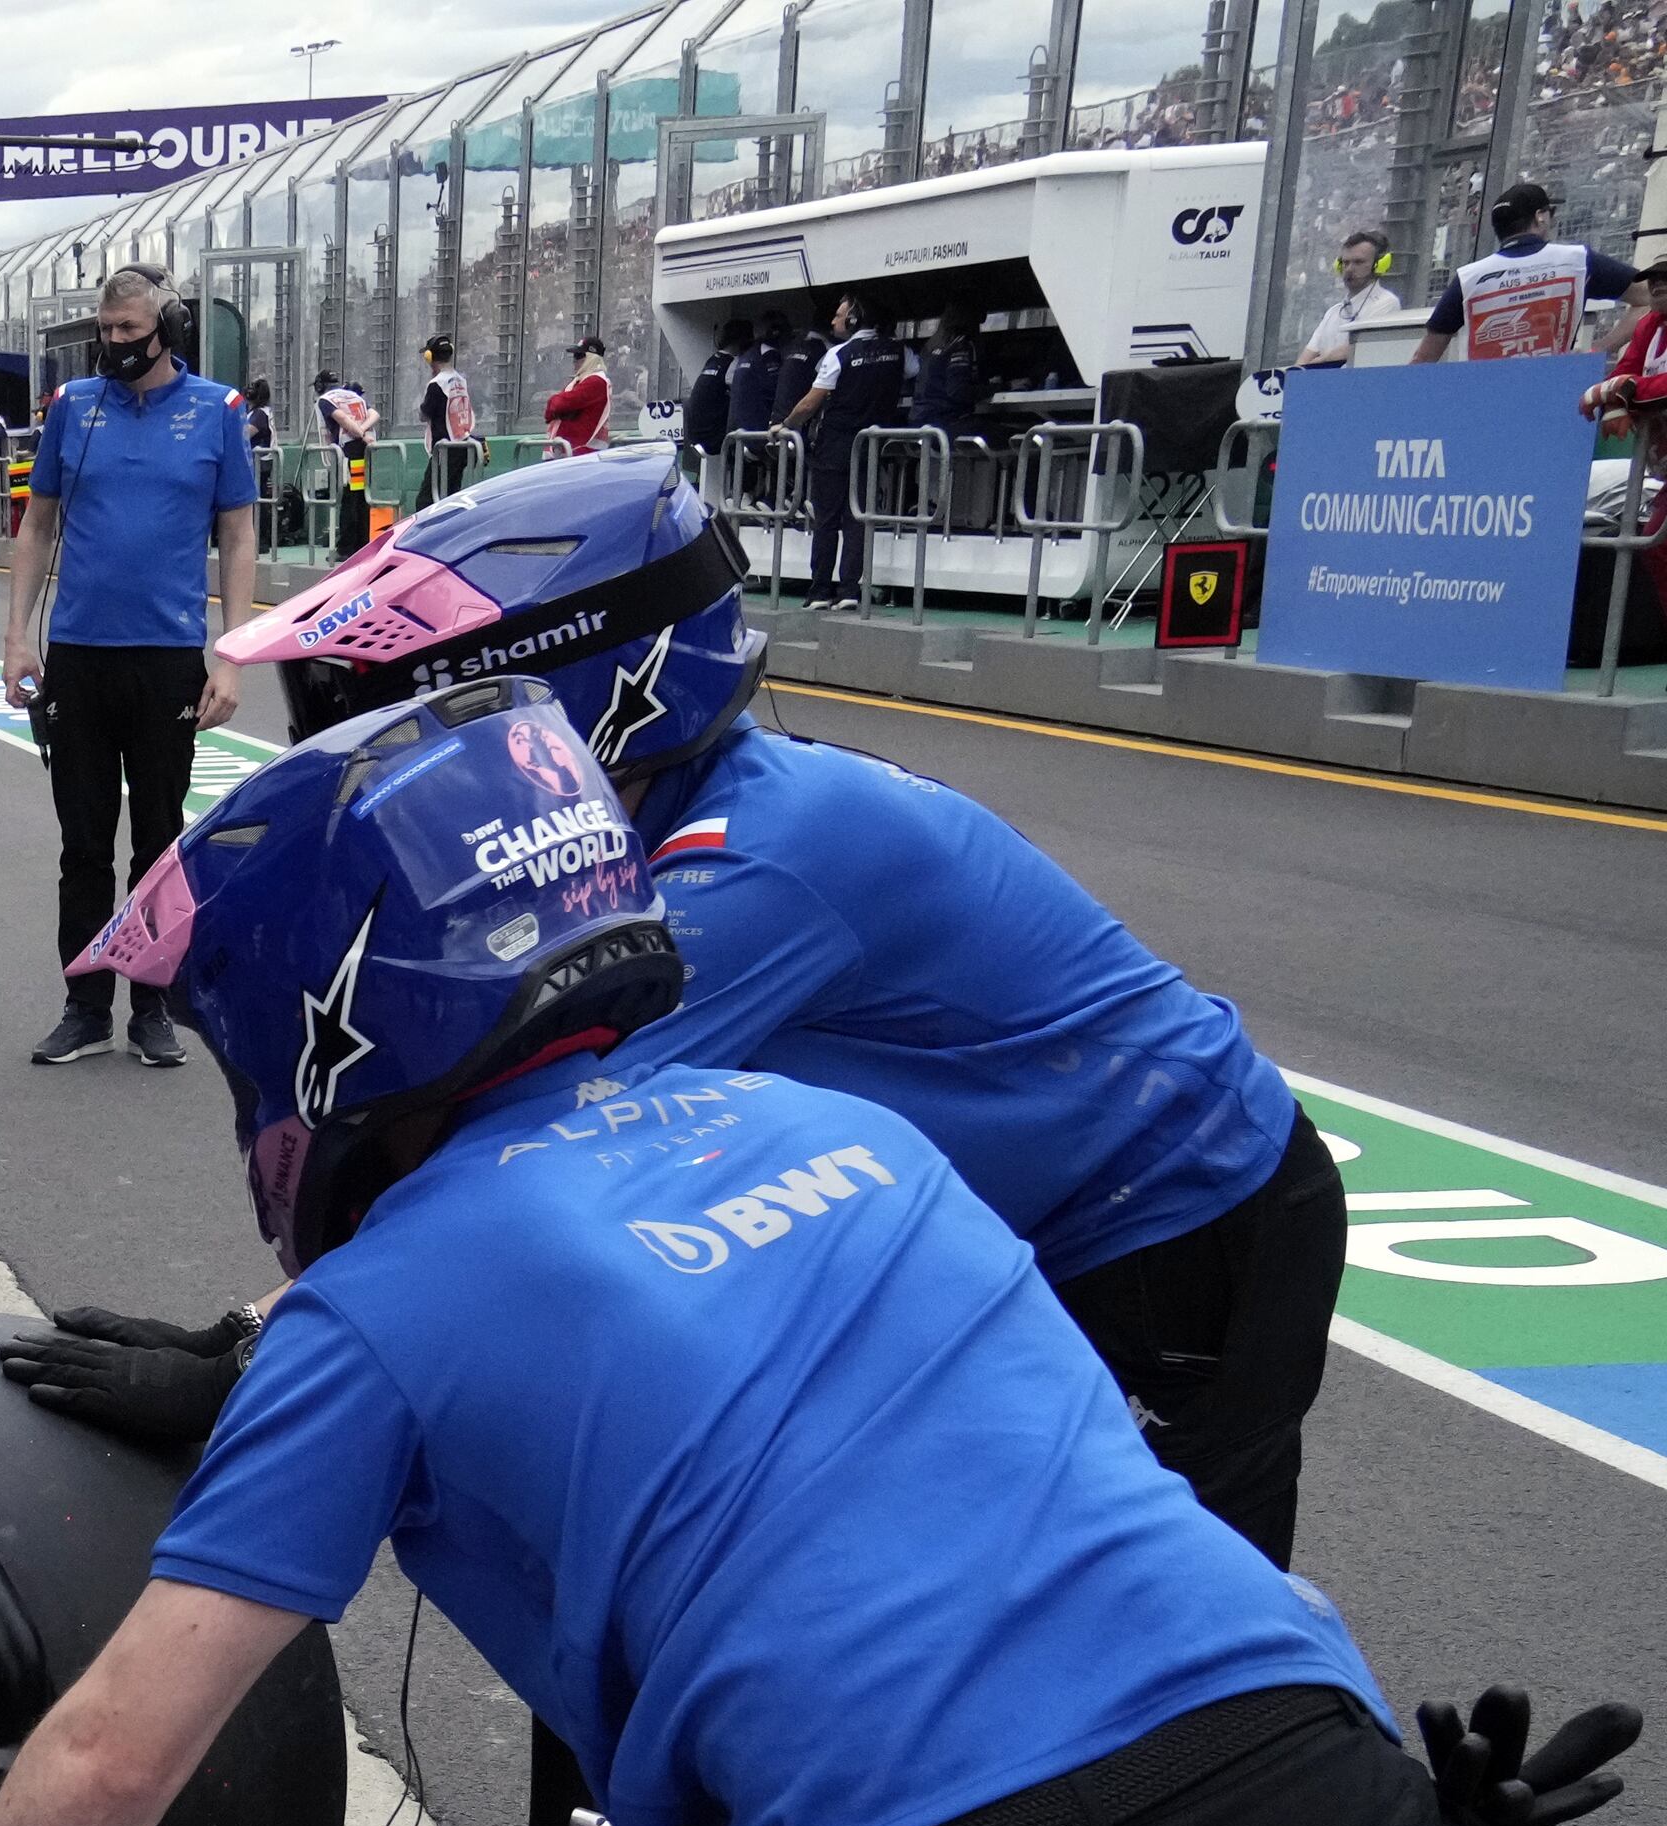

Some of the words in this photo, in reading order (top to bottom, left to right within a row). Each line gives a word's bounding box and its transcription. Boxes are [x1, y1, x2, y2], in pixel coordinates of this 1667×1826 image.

[885, 241, 968, 267] ALPHATAURI.FASHION
[705, 271, 770, 290] ALPHATAURI.FASHION
[1498, 279, 1521, 290] AUS
[1375, 438, 1446, 479] TATA
[1300, 493, 1534, 538] COMMUNICATIONS
[1307, 565, 1506, 605] #EmpoweringTomorrow
[317, 590, 373, 638] BWT
[459, 609, 608, 677] shamir
[358, 783, 391, 816] JONNY
[393, 740, 462, 788] GOODENOUGH
[474, 818, 504, 842] BWT
[475, 799, 614, 873] CHANGE
[491, 864, 526, 891] THE
[525, 828, 627, 888] WORLD
[655, 869, 716, 885] PFRE
[561, 885, 593, 917] sip
[595, 851, 619, 909] by
[618, 861, 639, 894] sip
[101, 890, 137, 944] BWT
[667, 909, 687, 918] ANK
[668, 927, 703, 936] RVICES
[498, 1074, 773, 1166] ALPINE
[645, 1112, 742, 1152] TEAM
[277, 1132, 299, 1194] BINANCE
[703, 1145, 897, 1250] BWT
